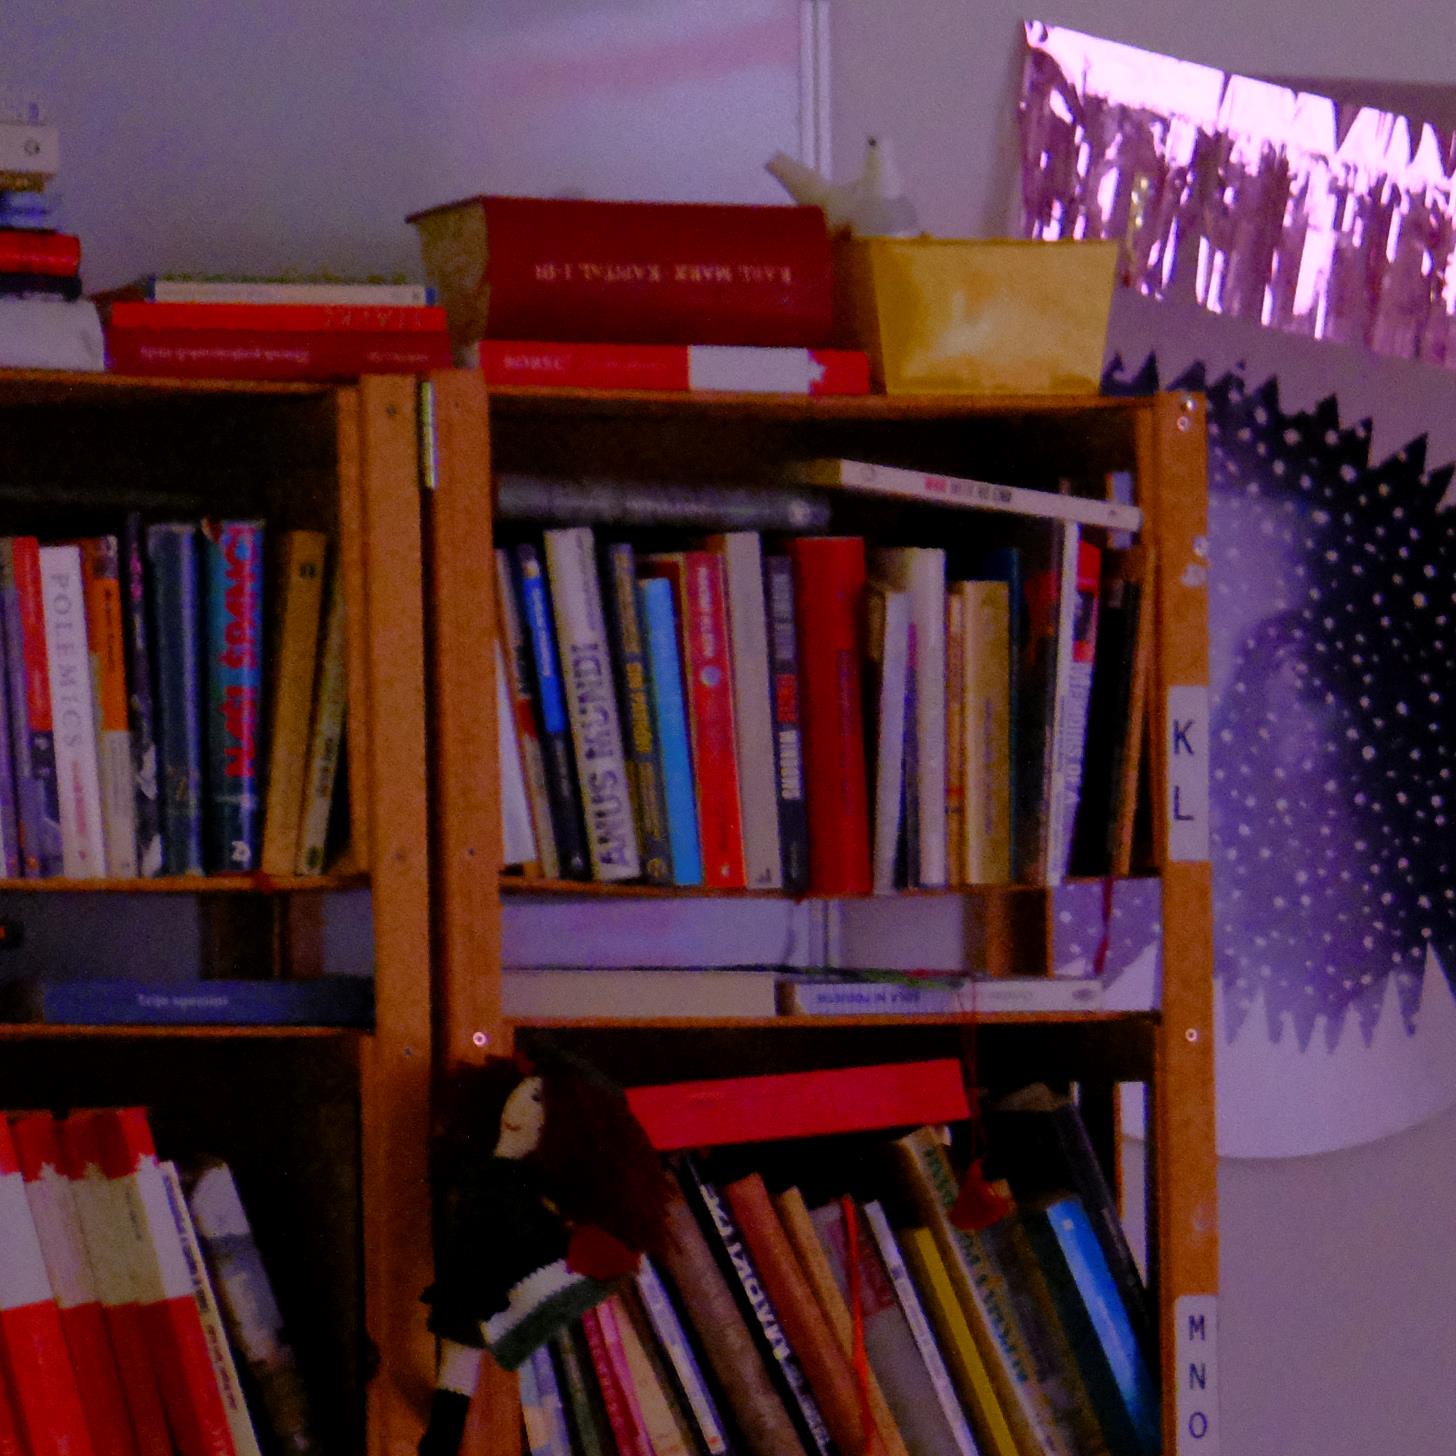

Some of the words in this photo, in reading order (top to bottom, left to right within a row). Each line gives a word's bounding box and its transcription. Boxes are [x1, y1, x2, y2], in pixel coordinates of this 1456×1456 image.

[578, 261, 661, 281] KAPITAL
[674, 262, 733, 282] MARX
[737, 264, 792, 283] KARL
[49, 571, 86, 750] POLEMICS
[573, 641, 613, 760] MUNDI
[1174, 719, 1194, 754] K
[1174, 786, 1194, 821] L
[591, 769, 629, 868] ANUS
[1189, 1317, 1206, 1342] M
[1189, 1366, 1206, 1391] N
[1189, 1412, 1207, 1439] O
